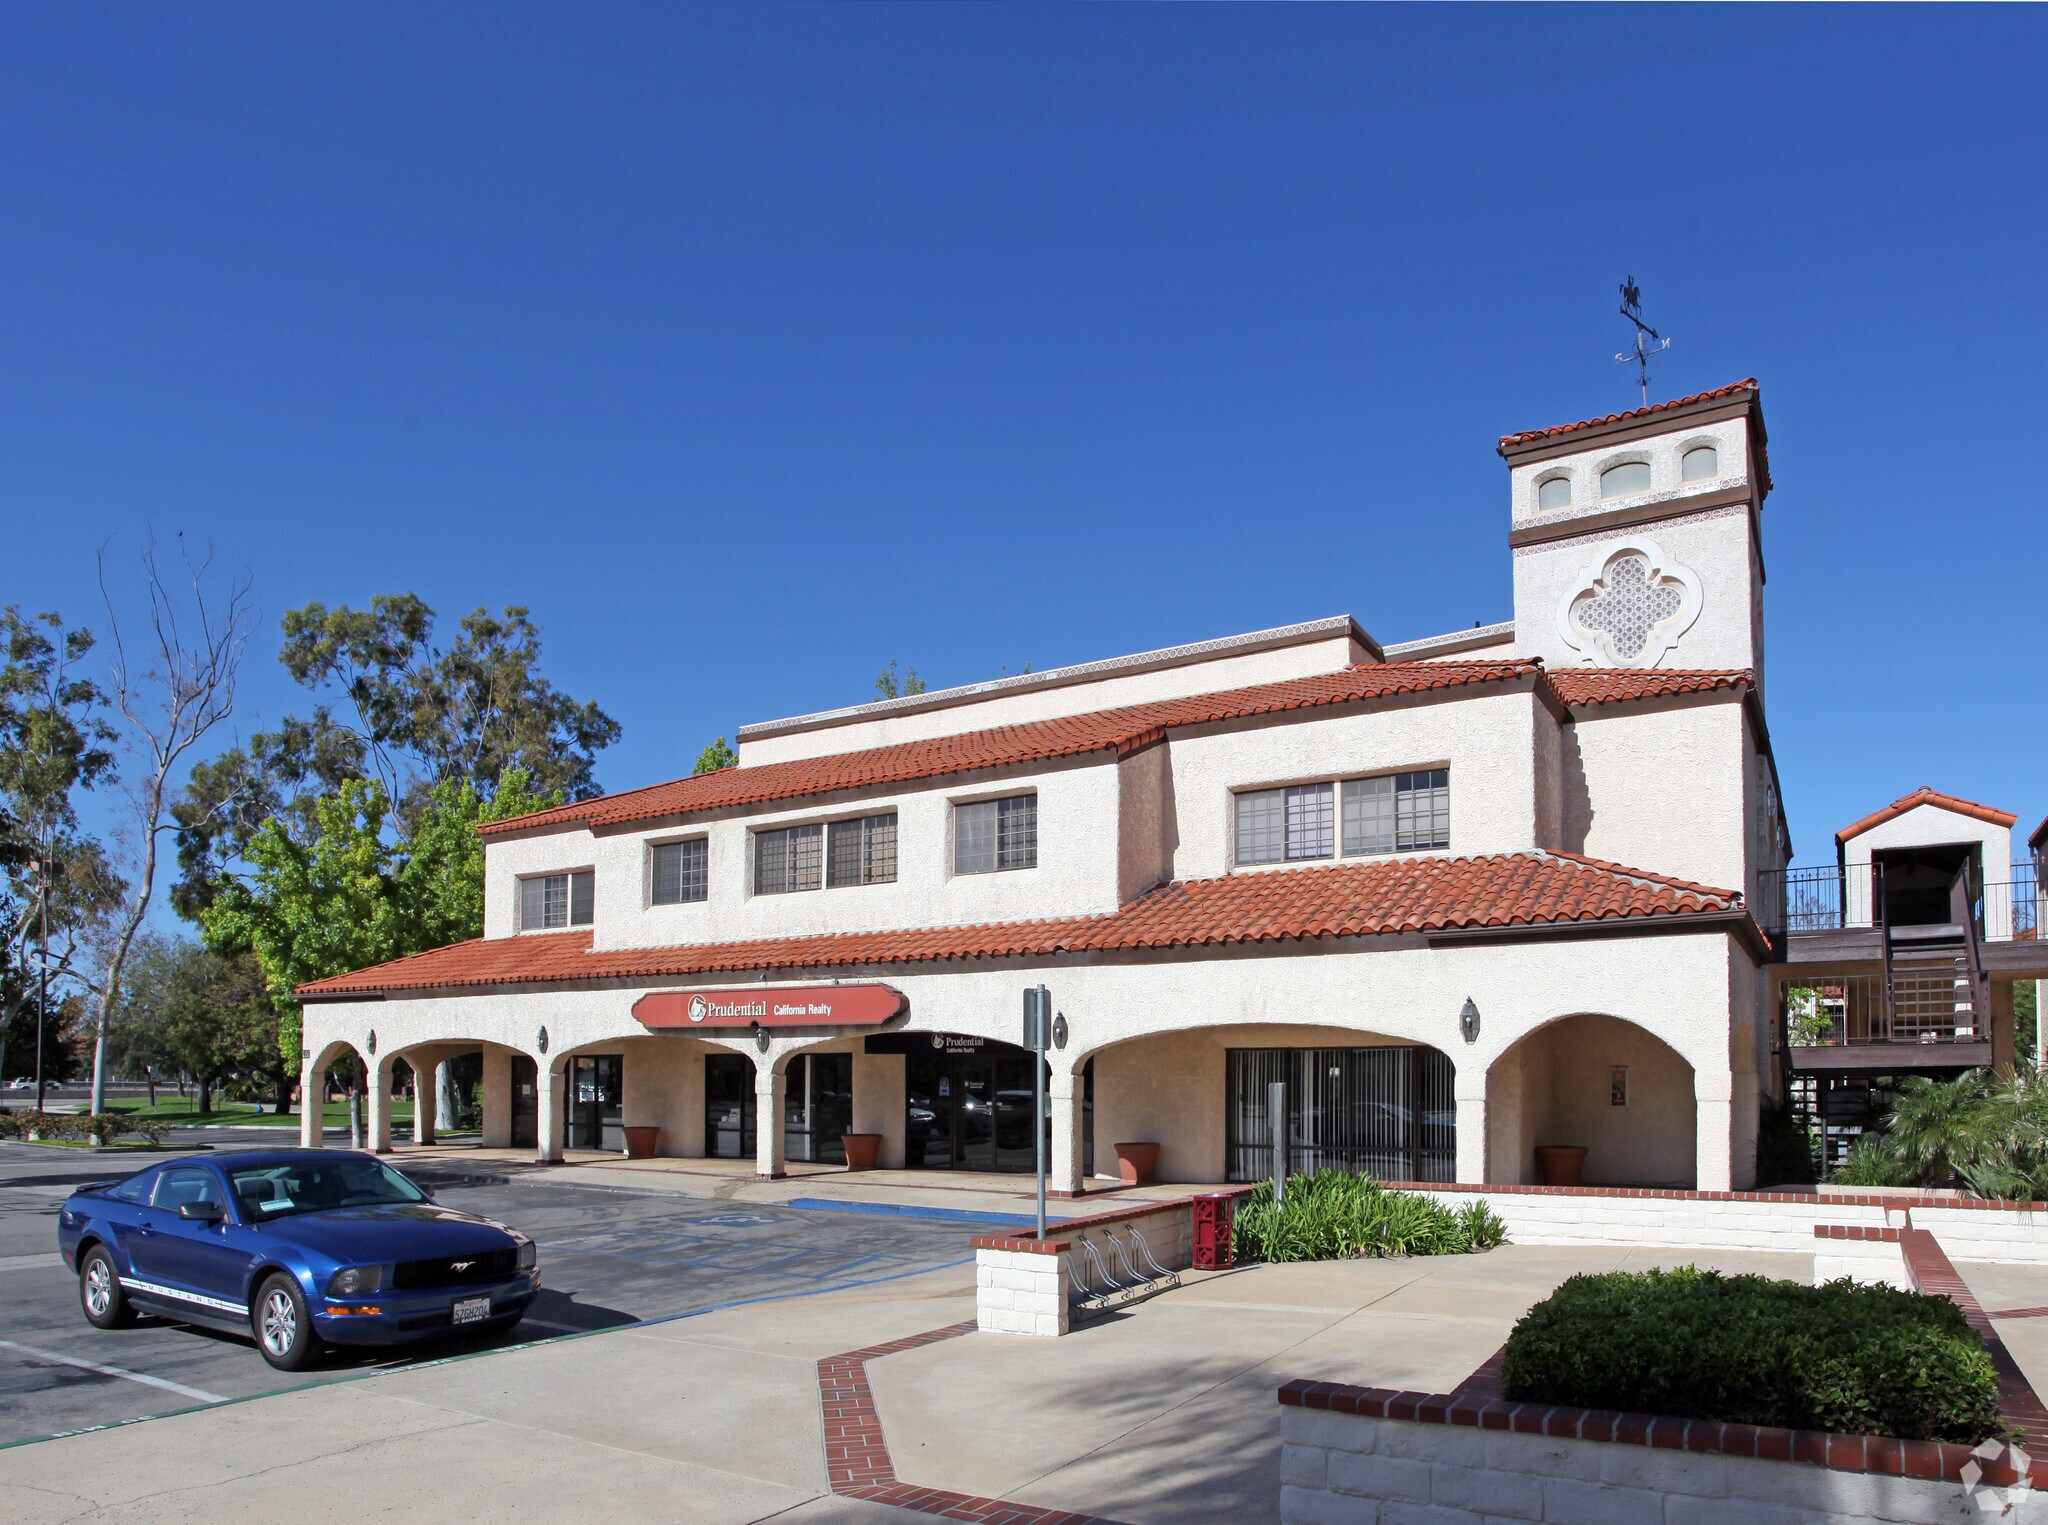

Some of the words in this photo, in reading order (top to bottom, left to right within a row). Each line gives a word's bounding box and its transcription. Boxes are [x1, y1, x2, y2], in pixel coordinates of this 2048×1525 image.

[708, 1001, 767, 1017] Prudential
[773, 1003, 806, 1016] California
[808, 1003, 832, 1016] Realty
[946, 1037, 984, 1046] Prudential
[148, 1284, 213, 1305] MUSTANG
[455, 1304, 489, 1319] 5ZGH204
